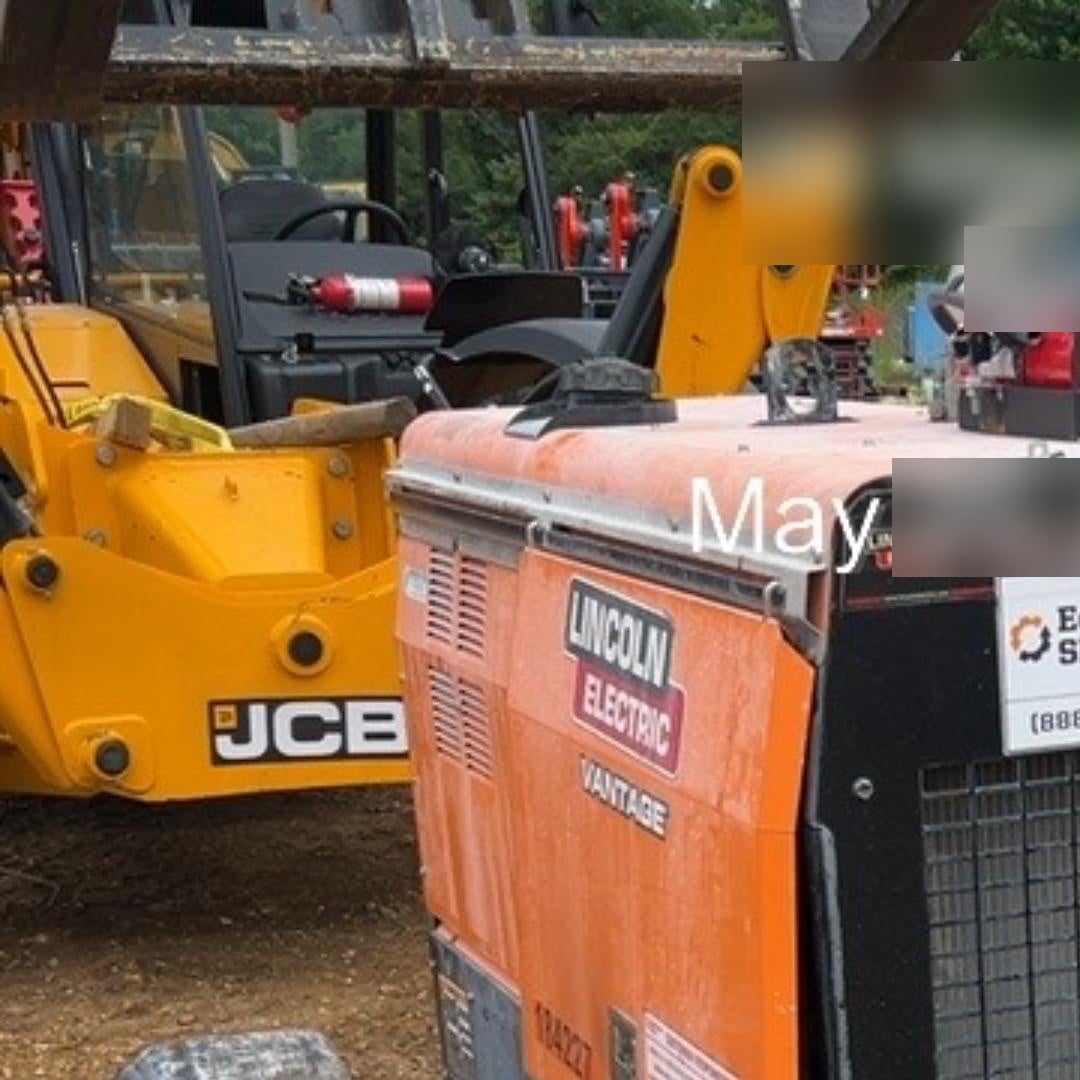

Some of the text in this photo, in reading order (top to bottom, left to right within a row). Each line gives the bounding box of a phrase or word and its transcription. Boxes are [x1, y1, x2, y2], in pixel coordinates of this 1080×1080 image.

[569, 590, 668, 688] LINCOLN
[214, 700, 409, 761] JCB
[583, 673, 671, 757] ELECTRIC
[580, 756, 669, 837] VANTAGE
